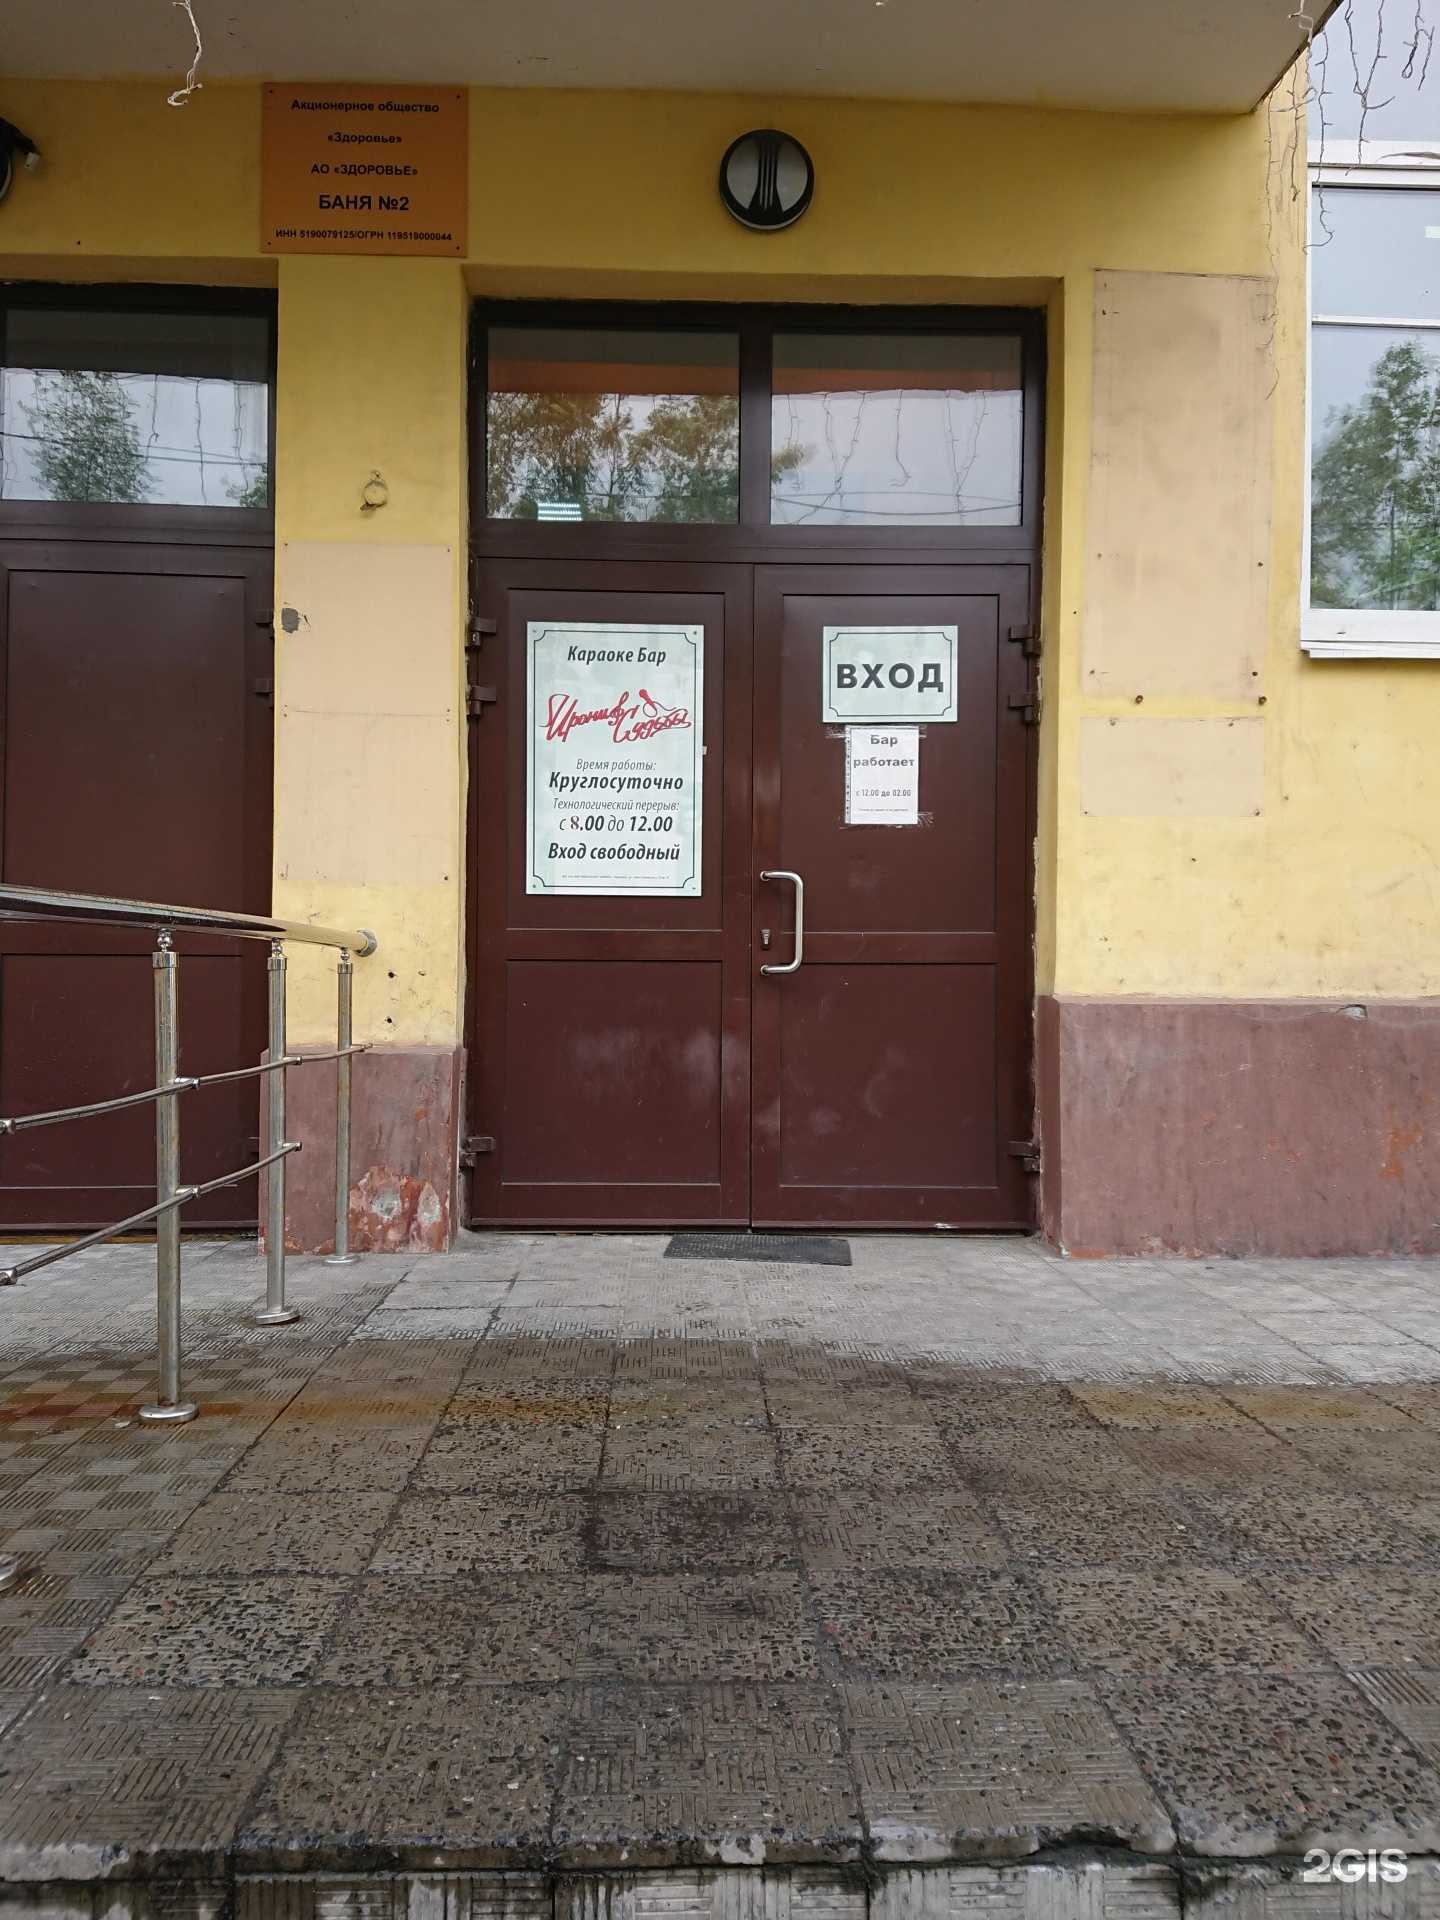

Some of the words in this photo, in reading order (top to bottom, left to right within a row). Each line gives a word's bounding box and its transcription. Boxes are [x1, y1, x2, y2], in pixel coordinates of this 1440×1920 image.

[291, 100, 374, 112] Акционерное
[378, 102, 439, 113] общество
[328, 133, 402, 144] «Здоровье»
[311, 164, 329, 174] АО
[334, 165, 418, 176] «ЗДОРОВЬЕ»
[319, 195, 372, 210] БАНЯ
[379, 197, 409, 211] №2
[568, 646, 634, 664] Караоке
[637, 648, 666, 666] Бар
[837, 663, 944, 693] ВХОД
[871, 735, 898, 747] Бар
[576, 759, 609, 770] Время
[611, 760, 656, 772] работы:
[853, 757, 915, 768] работает
[549, 772, 684, 792] Круглосуточно
[553, 798, 634, 811] Технологический
[635, 800, 680, 812] перерыв:
[559, 819, 566, 830] с
[570, 816, 604, 831] 8.00
[608, 816, 624, 832] до
[630, 816, 673, 832] 12.00
[548, 843, 586, 859] Вход
[590, 843, 680, 860] свободный
